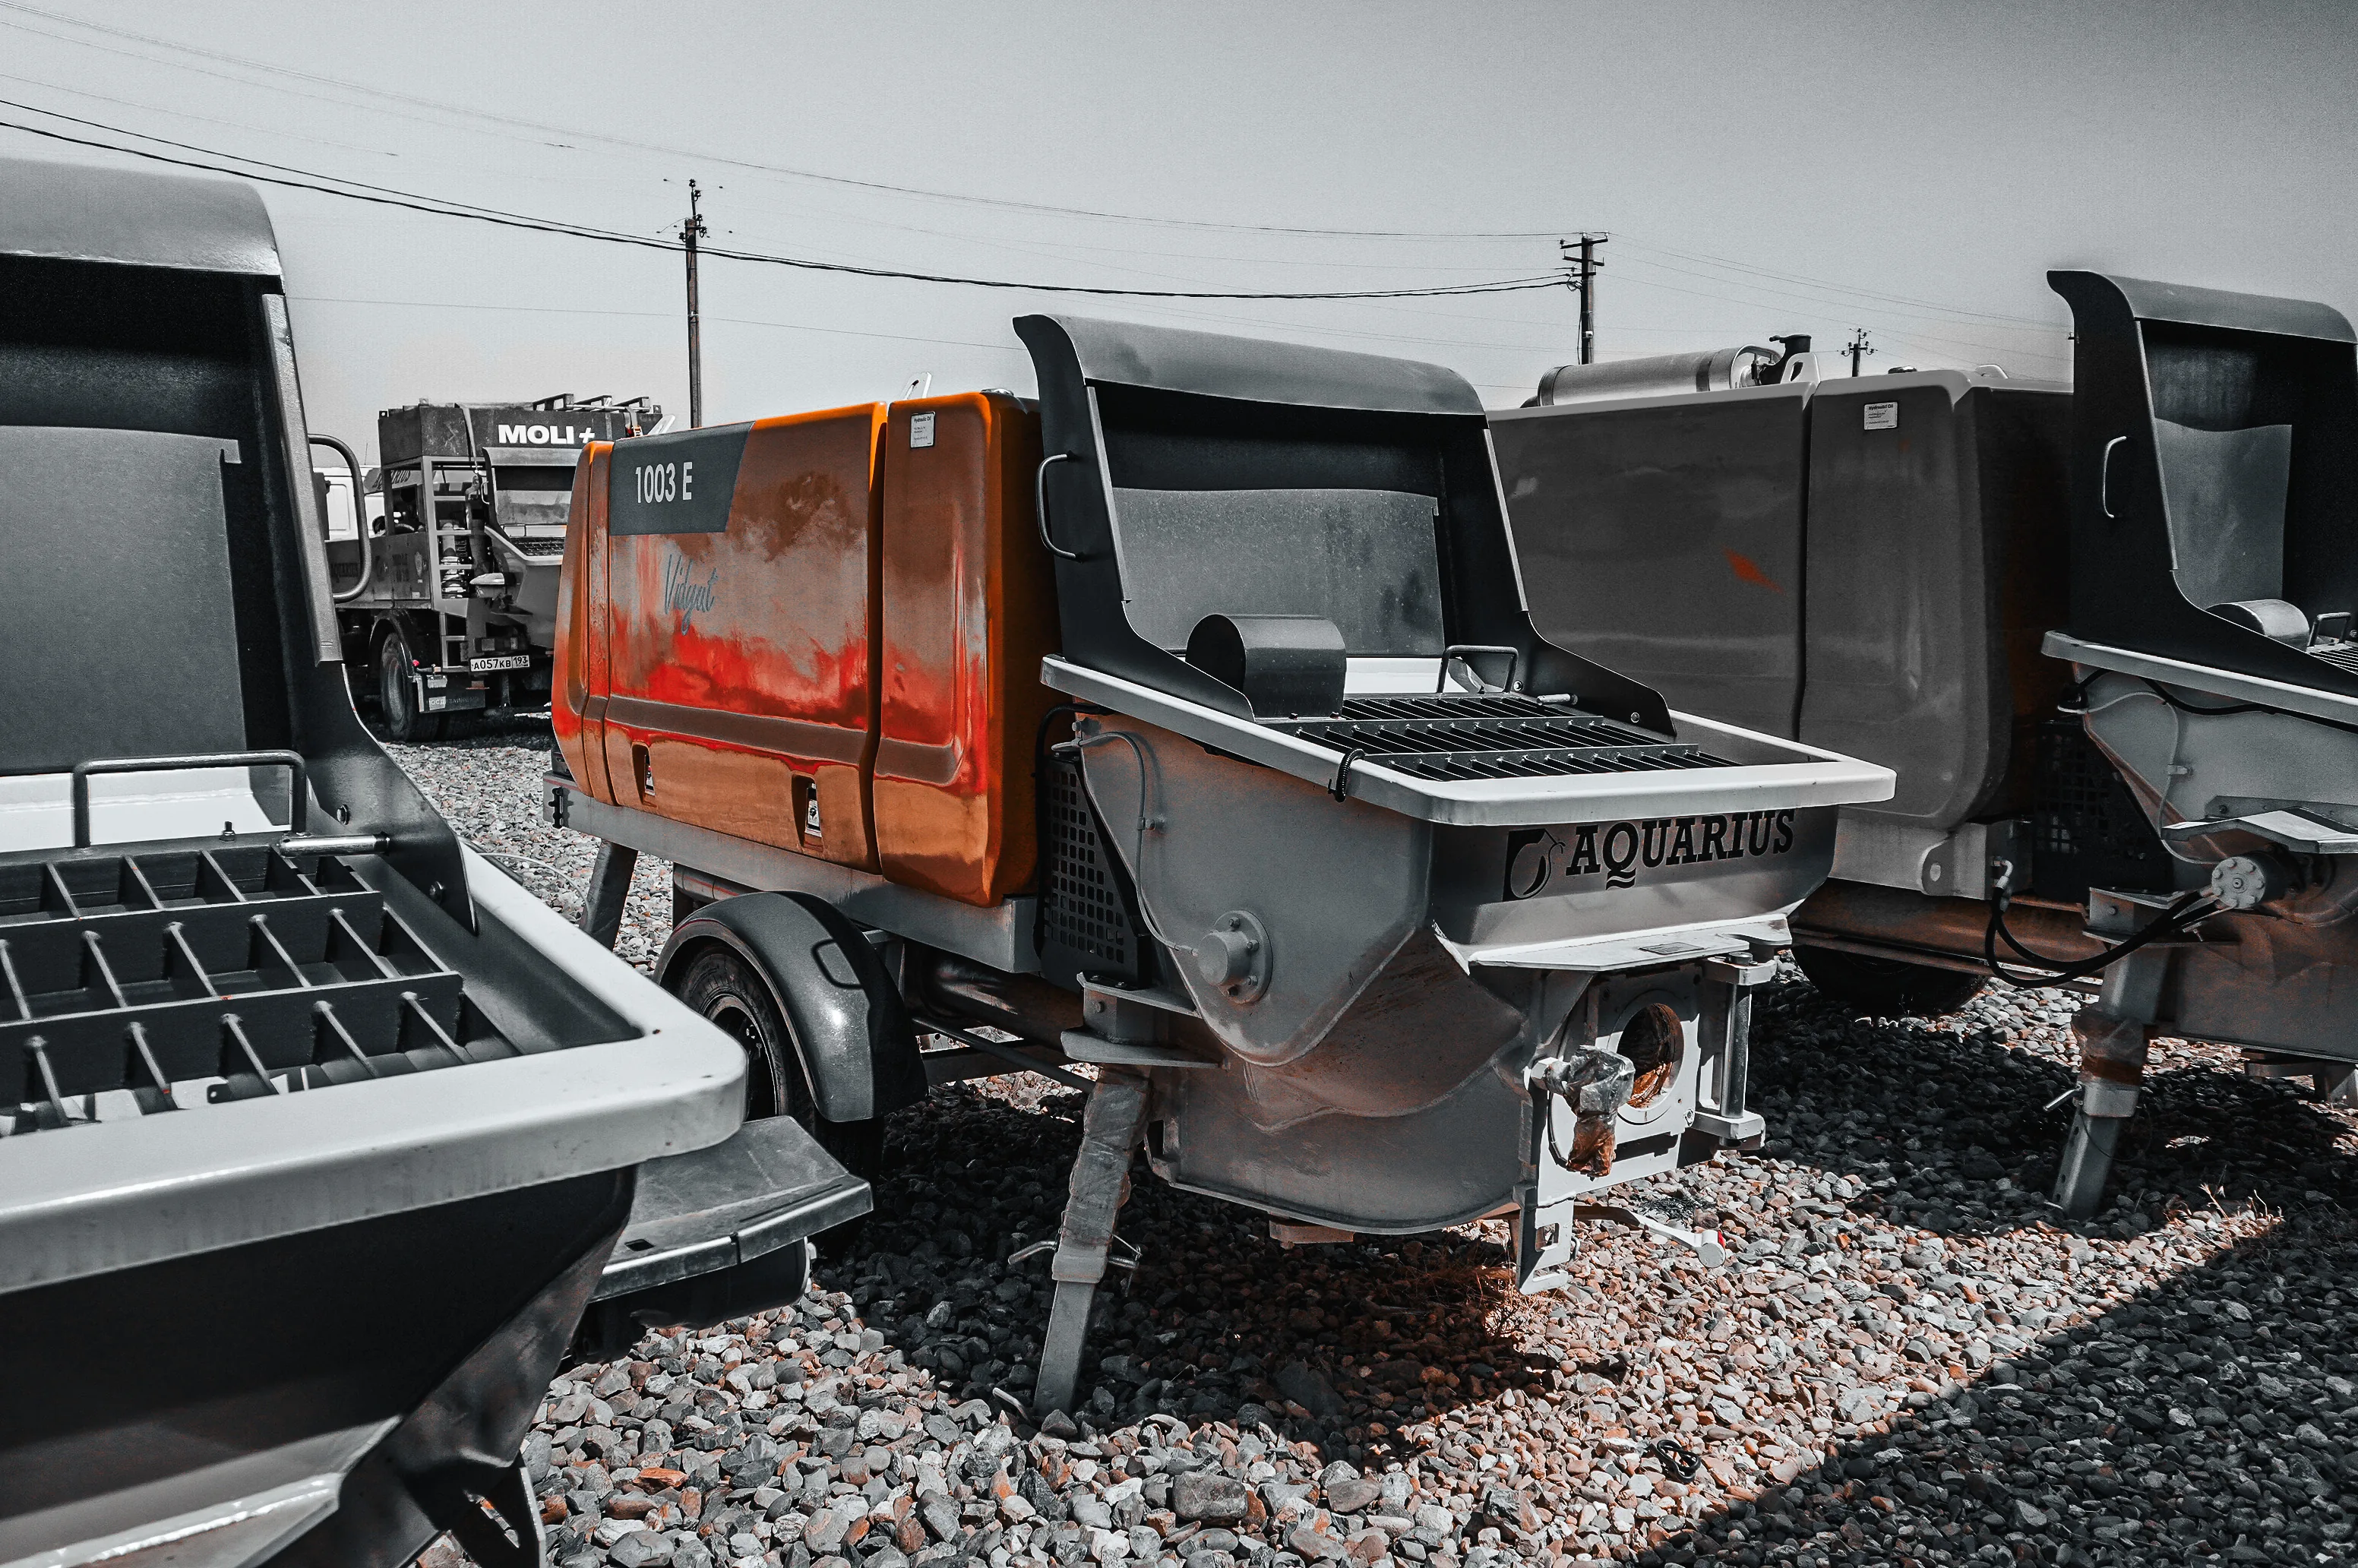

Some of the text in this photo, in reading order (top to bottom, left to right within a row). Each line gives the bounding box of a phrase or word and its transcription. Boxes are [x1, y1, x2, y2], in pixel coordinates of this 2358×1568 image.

[498, 424, 574, 444] MOLI
[635, 461, 693, 504] 1003 E
[513, 656, 529, 665] 193
[1565, 808, 1796, 890] AQUARIUS
